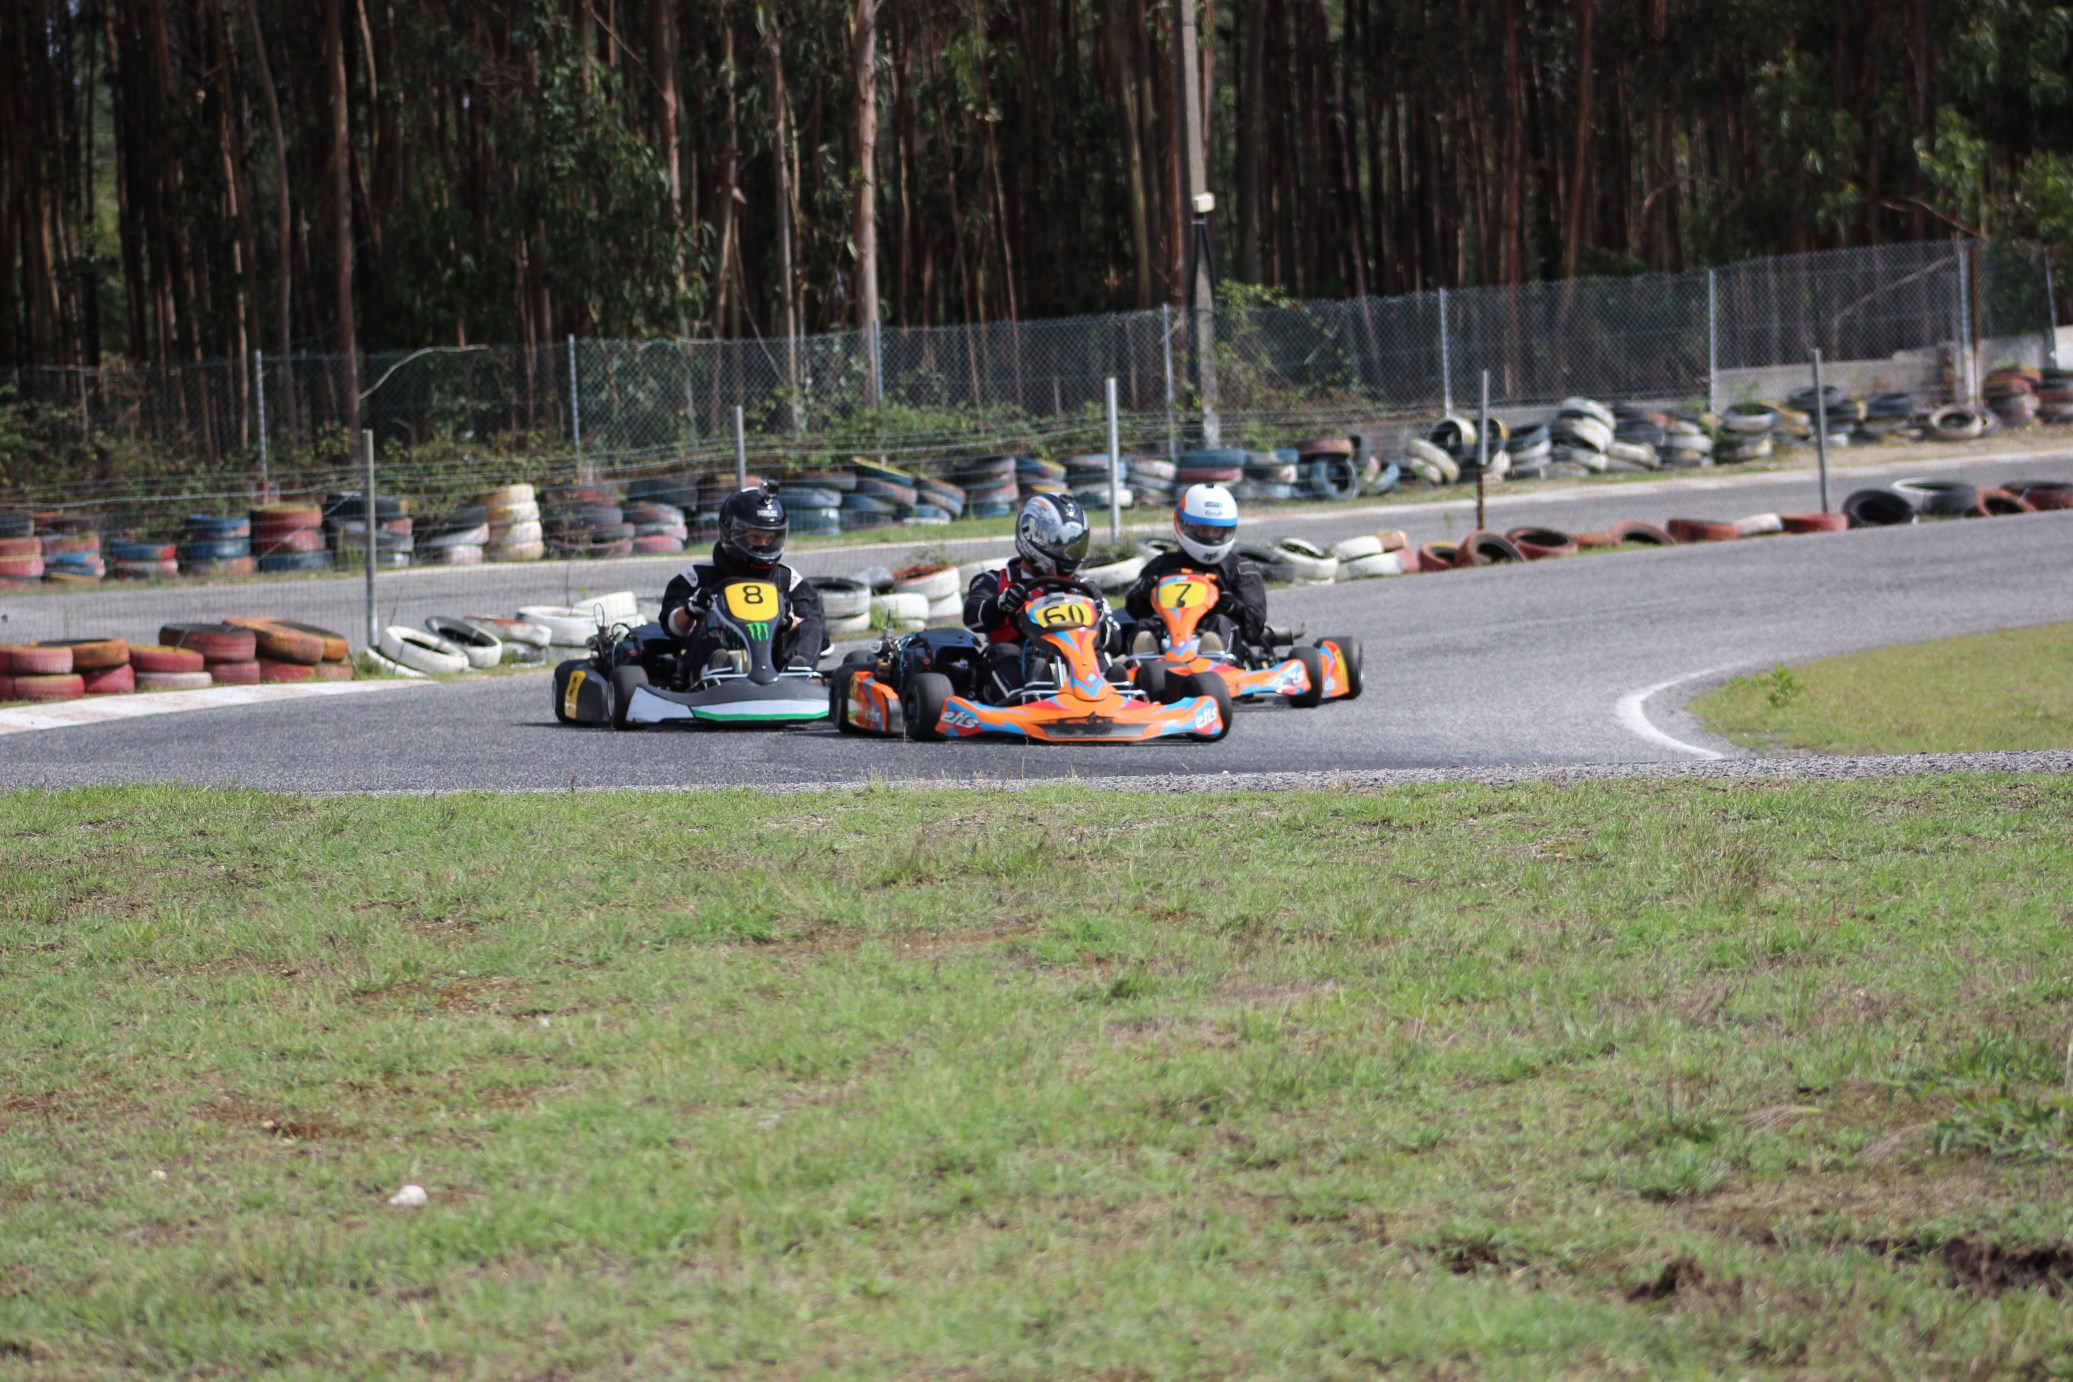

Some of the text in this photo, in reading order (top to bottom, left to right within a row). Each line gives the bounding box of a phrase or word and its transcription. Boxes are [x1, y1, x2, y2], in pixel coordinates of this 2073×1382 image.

[742, 585, 764, 604] 8
[1175, 583, 1192, 607] 7
[1043, 604, 1085, 624] 60
